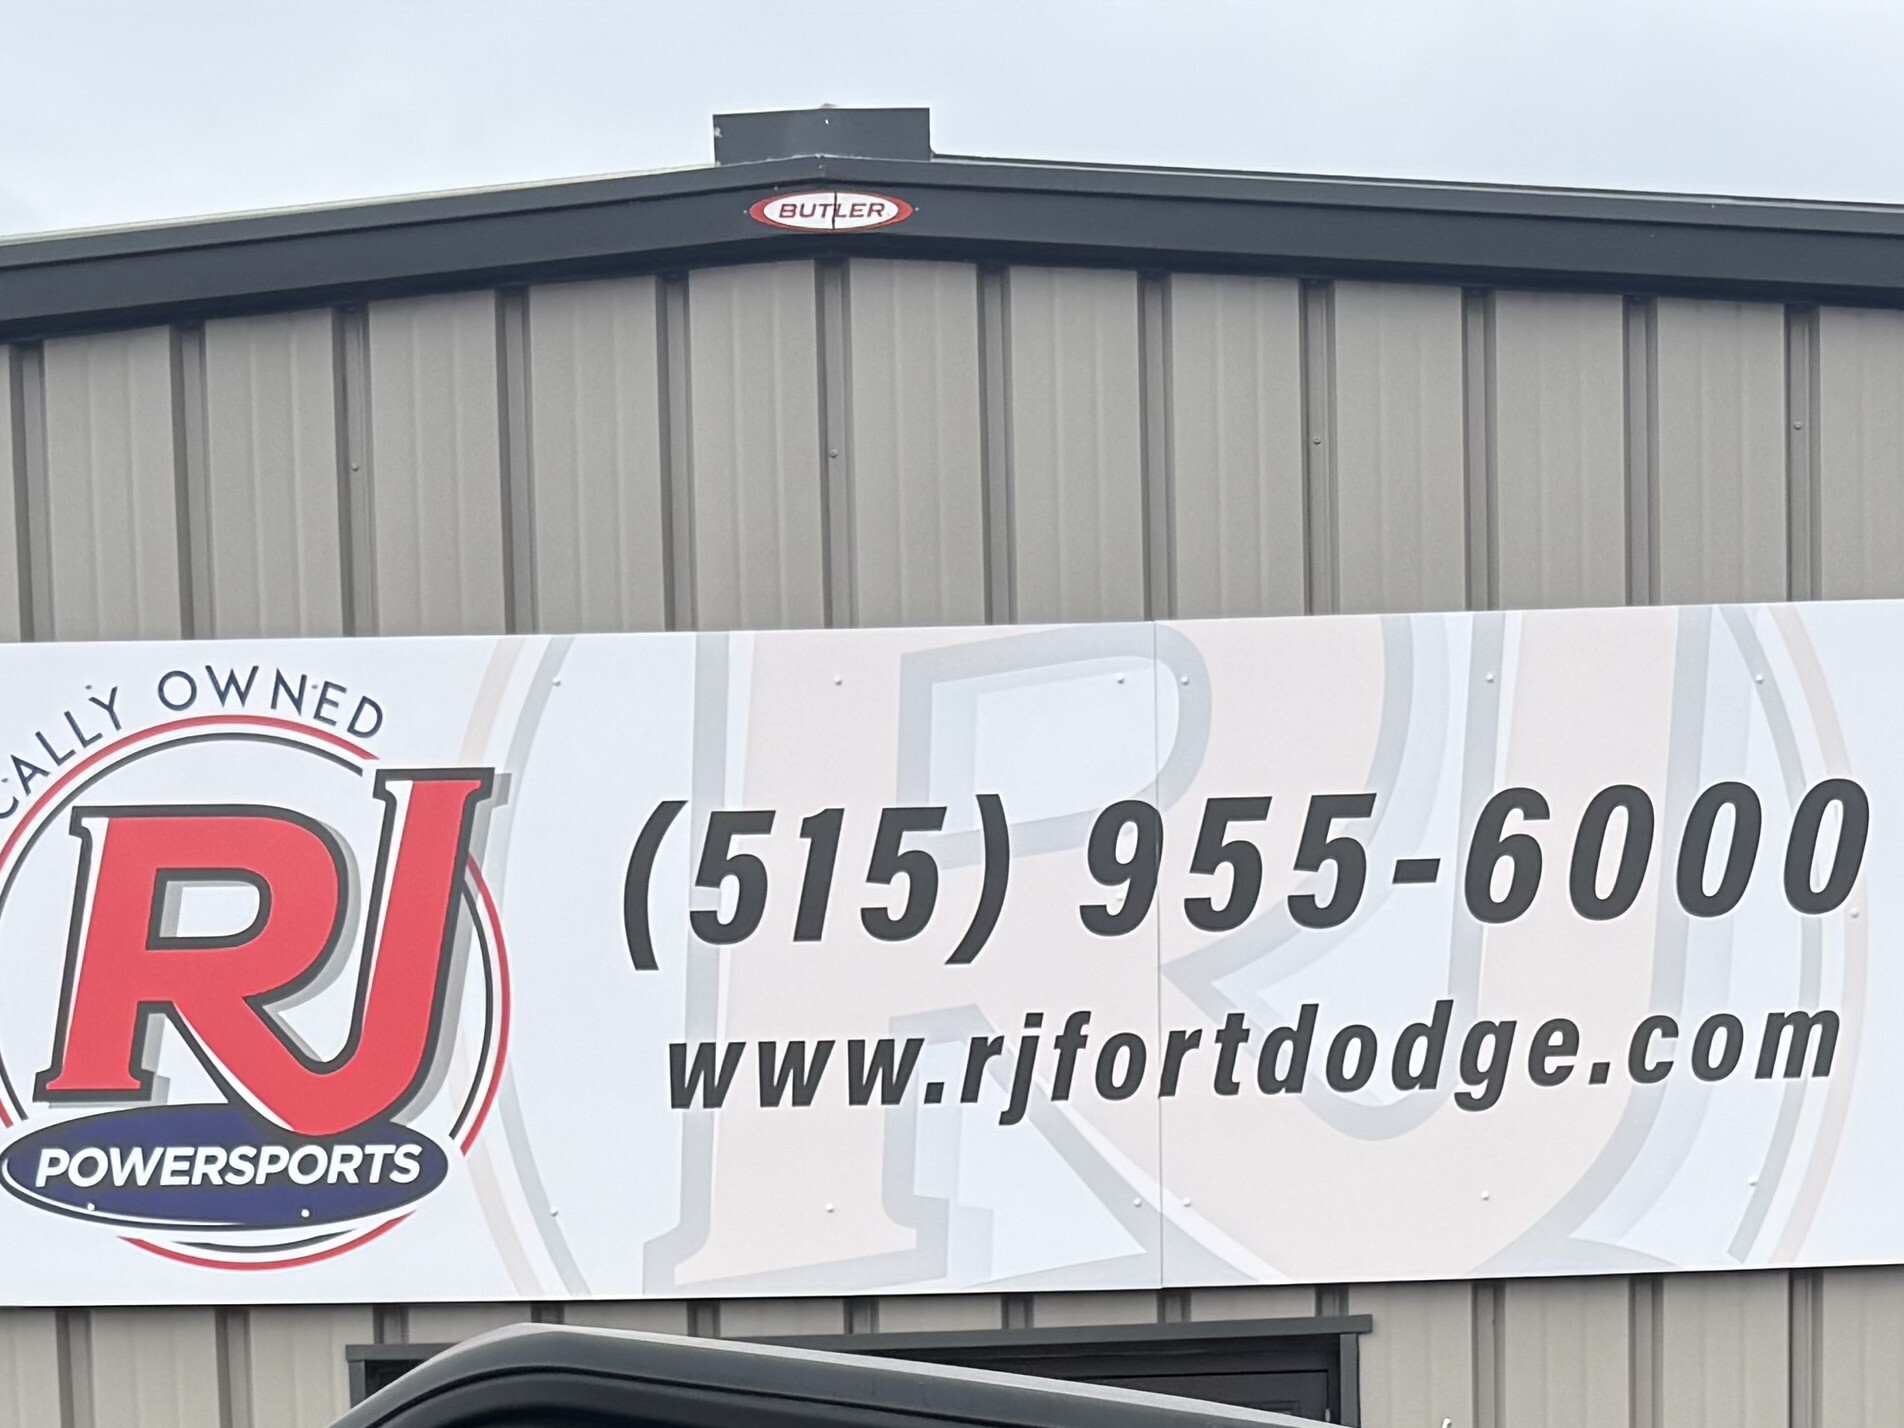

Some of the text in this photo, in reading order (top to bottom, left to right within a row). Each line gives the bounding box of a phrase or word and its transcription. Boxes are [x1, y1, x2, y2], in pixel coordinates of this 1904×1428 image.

[778, 202, 885, 219] BUTLER
[157, 664, 384, 739] OWNED
[623, 777, 1871, 972] (515) 955-6000
[33, 767, 495, 1136] RJ
[667, 999, 1843, 1127] www.rjfortdodge.com
[34, 1143, 423, 1188] POWERSPORTS
